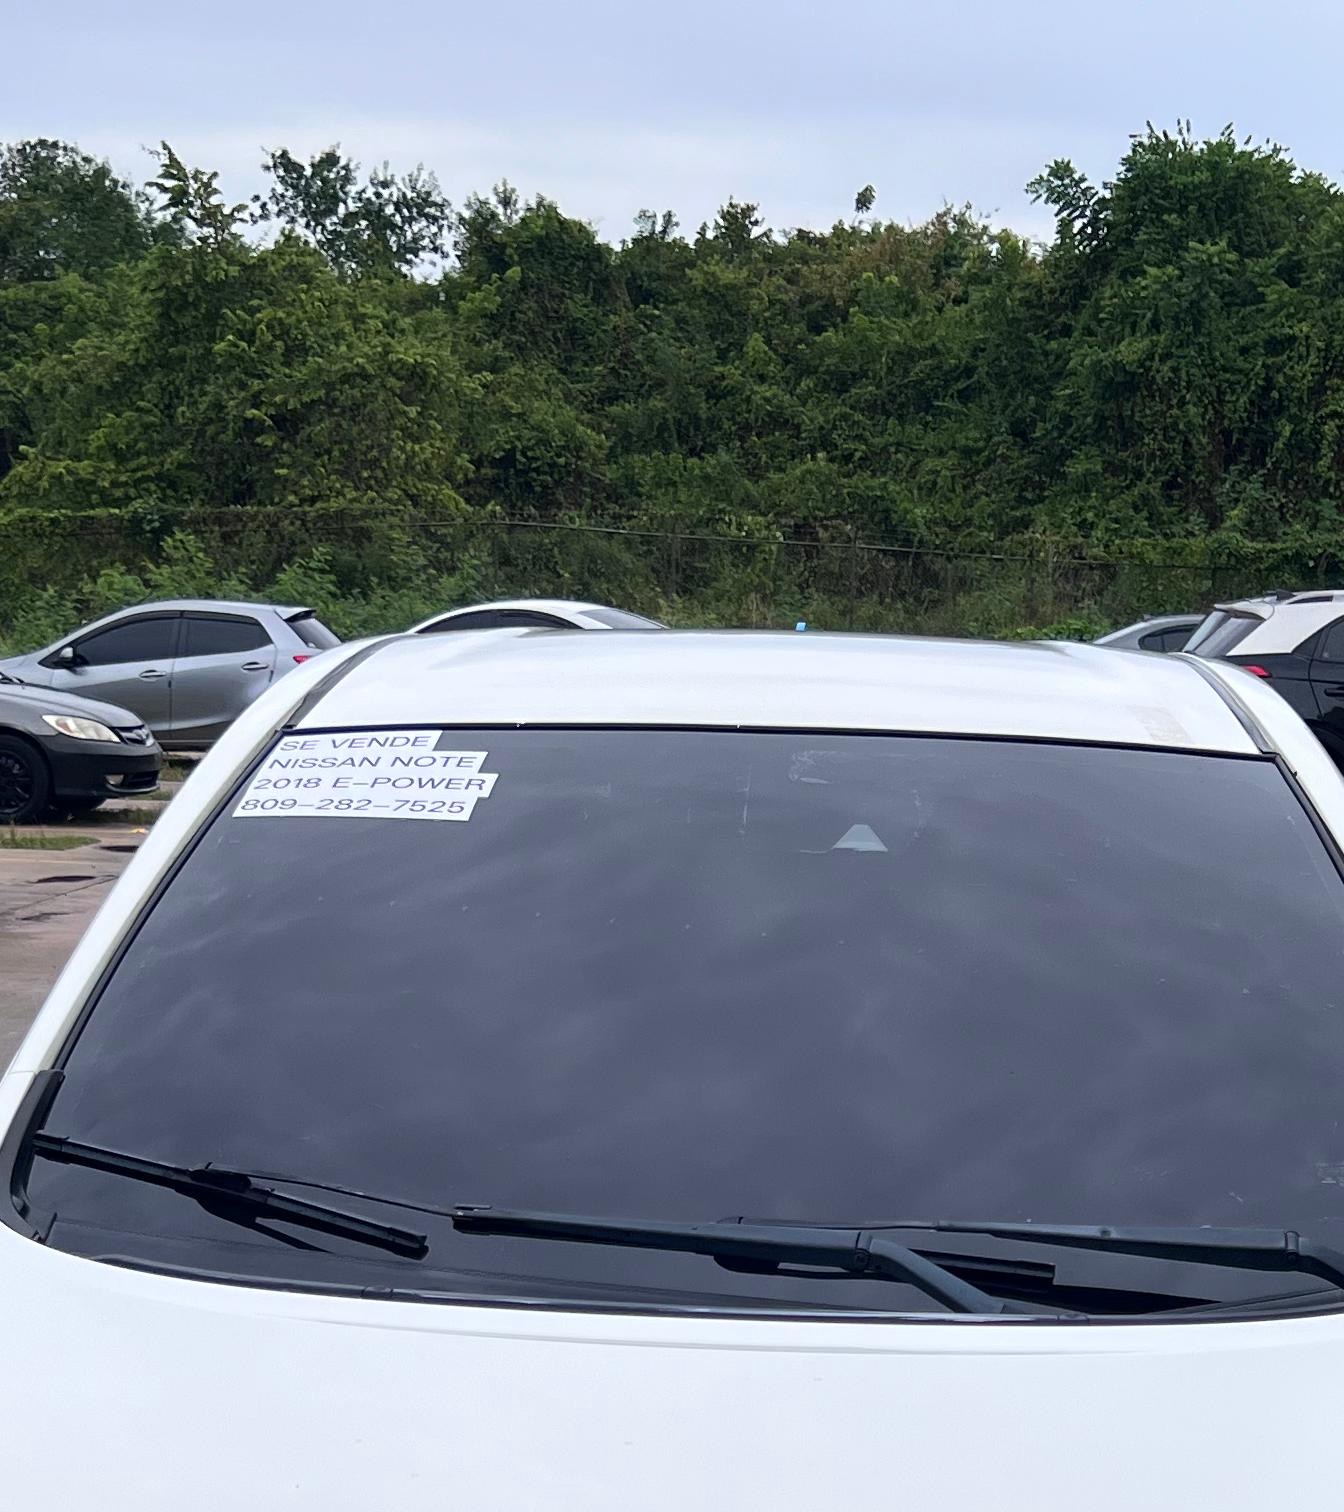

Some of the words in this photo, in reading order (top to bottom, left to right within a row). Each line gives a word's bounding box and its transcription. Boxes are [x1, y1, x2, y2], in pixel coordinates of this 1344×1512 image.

[279, 739, 319, 751] SE
[331, 736, 431, 749] VENDE
[268, 756, 381, 769] NISSAN
[390, 756, 478, 768] NOTE
[253, 777, 322, 790] 2018
[332, 777, 487, 791] E-POWER
[240, 798, 467, 814] 809-282-7525
